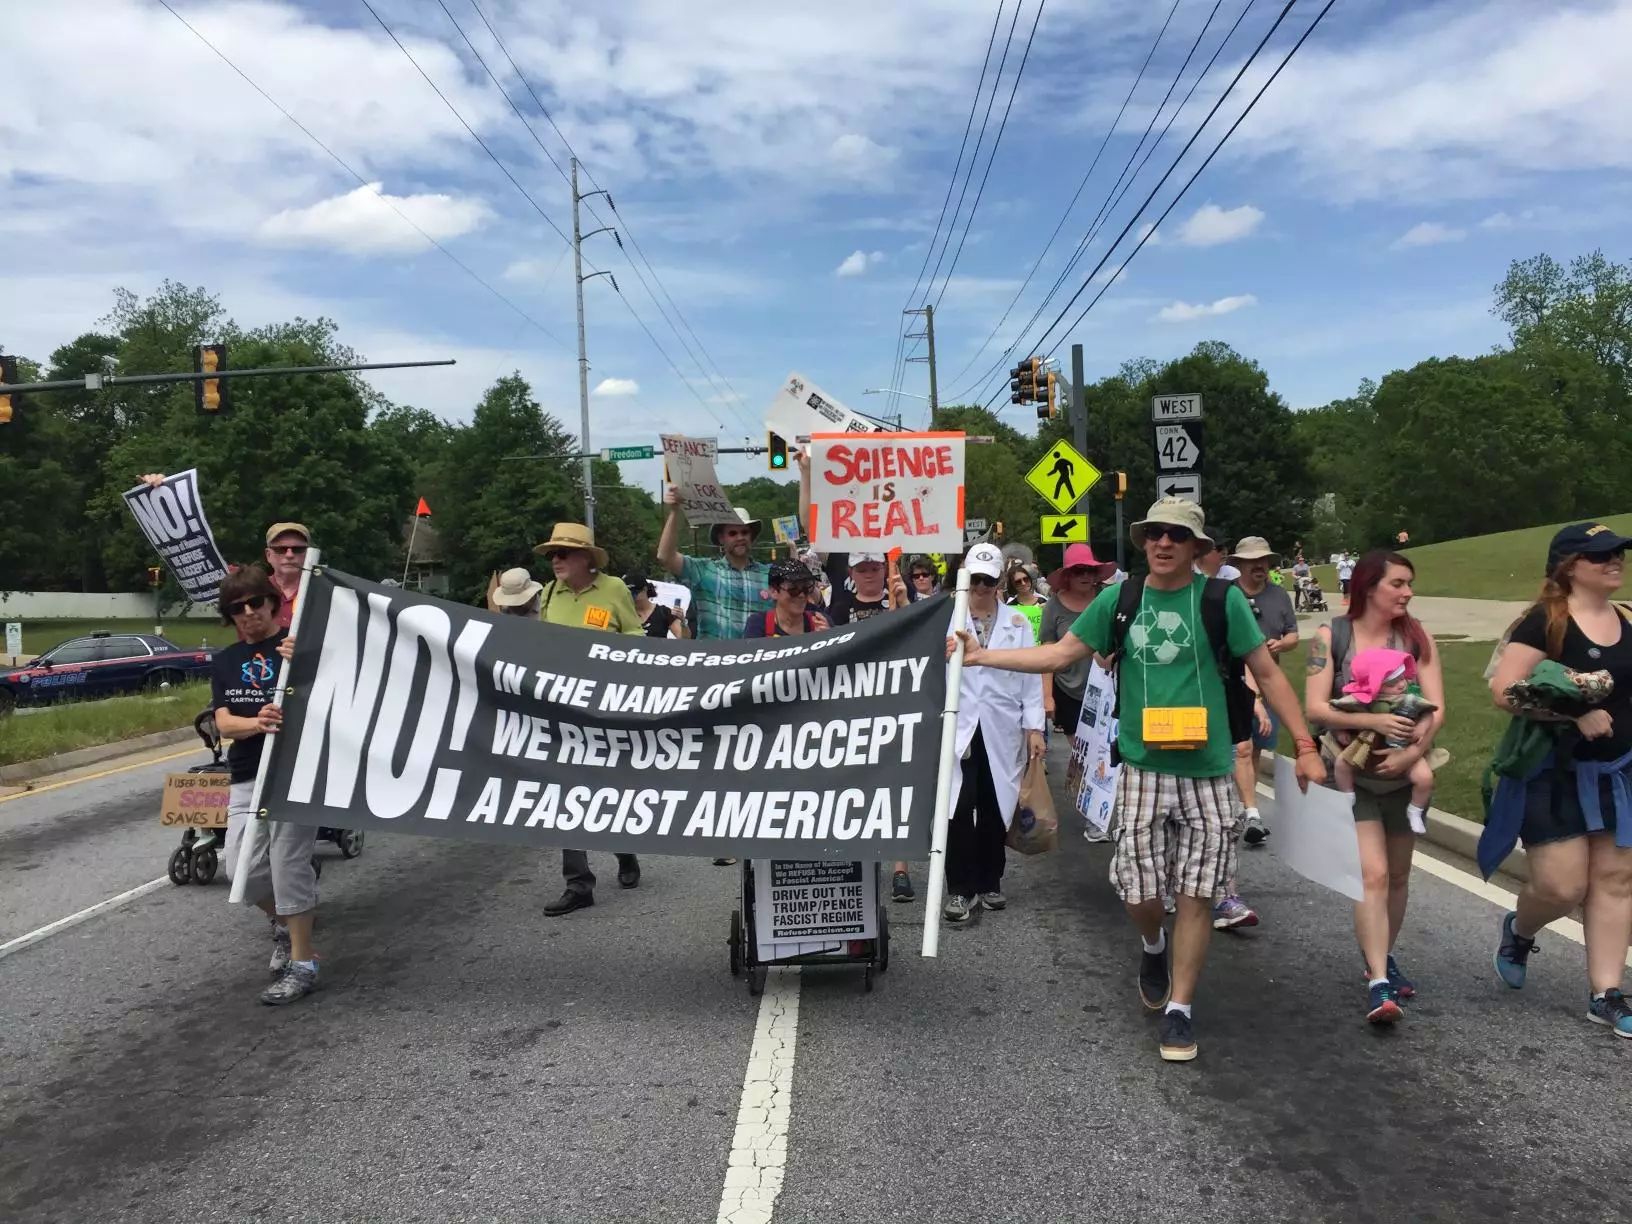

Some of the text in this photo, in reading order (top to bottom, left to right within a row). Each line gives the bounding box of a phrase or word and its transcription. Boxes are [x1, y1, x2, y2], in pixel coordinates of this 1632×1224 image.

[1160, 399, 1194, 414] WEST
[1159, 427, 1179, 435] CONN
[610, 449, 642, 459] Freedom
[1162, 436, 1188, 462] 42
[823, 444, 954, 485] SCIENCE
[694, 483, 723, 498] FOR
[873, 482, 896, 502] IS
[128, 478, 201, 545] NO!
[831, 498, 940, 539] REAL
[967, 520, 984, 528] WEST
[588, 631, 856, 667] RefuseFascism.org
[31, 672, 88, 688] POLICE
[492, 656, 930, 714] IN THE NAME OF HUMANITY
[287, 585, 494, 820] NO!
[491, 708, 923, 771] WE REFUSE TO ACCEPT
[168, 777, 173, 787] I
[174, 778, 196, 789] USED
[198, 778, 209, 788] TO
[465, 776, 914, 841] A FASCIST AMERICA!
[162, 811, 209, 826] SAVES
[776, 870, 787, 878] We
[788, 869, 816, 877] REFUSE
[828, 866, 854, 875] Accept
[814, 860, 821, 868] of
[811, 875, 845, 883] America!
[773, 885, 863, 901] DRIVE OUT THE
[773, 898, 864, 914] TRUMP/PENCE
[773, 911, 863, 926] FASCIST REGIME
[777, 926, 861, 937] RefuseFascism.org
